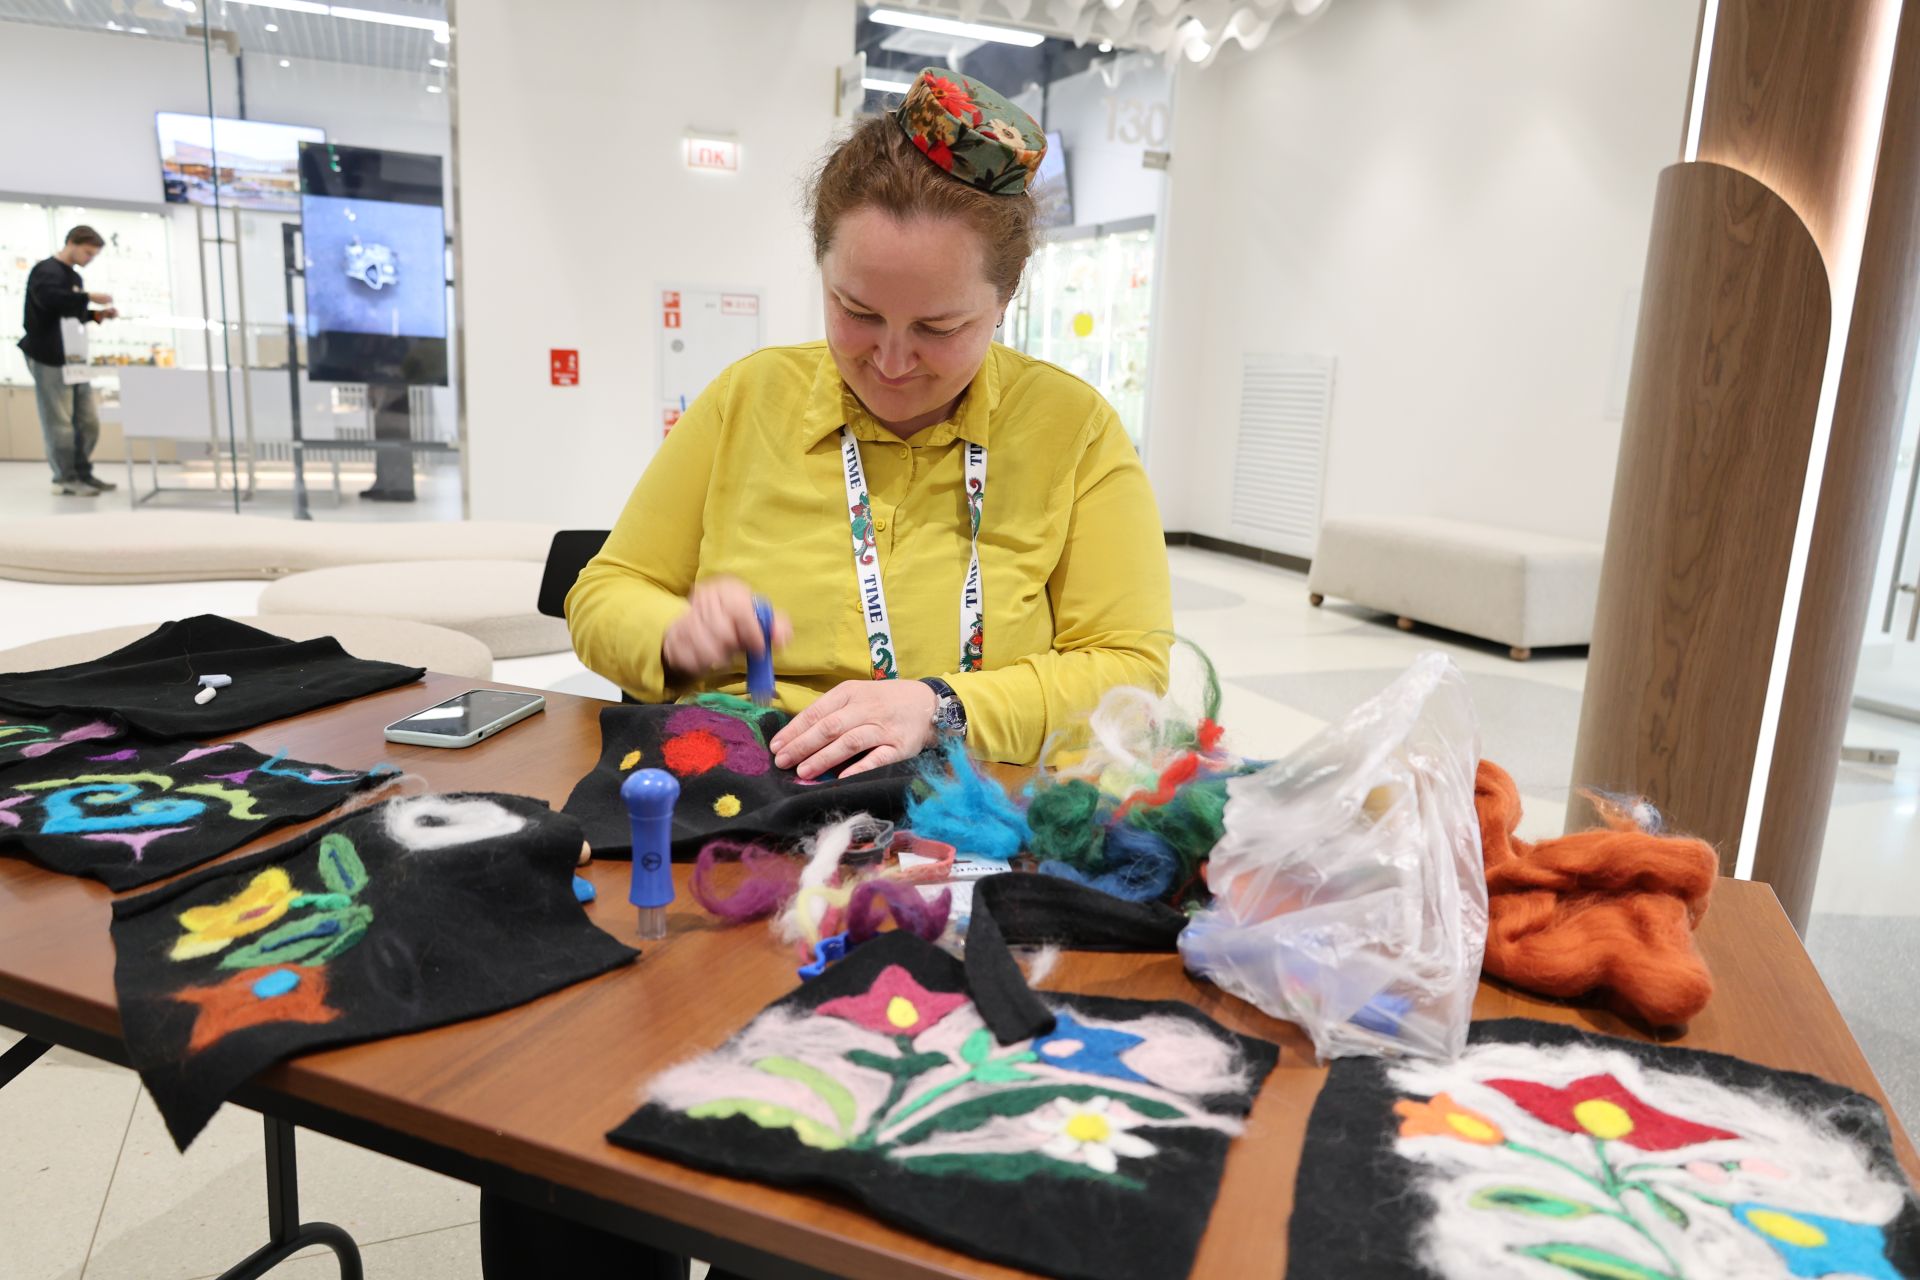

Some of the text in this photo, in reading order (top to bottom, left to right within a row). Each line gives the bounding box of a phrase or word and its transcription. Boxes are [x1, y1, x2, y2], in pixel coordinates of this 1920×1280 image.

[1103, 96, 1169, 147] 130
[846, 443, 862, 490] TIME
[970, 442, 983, 466] TI
[864, 574, 883, 623] TIME
